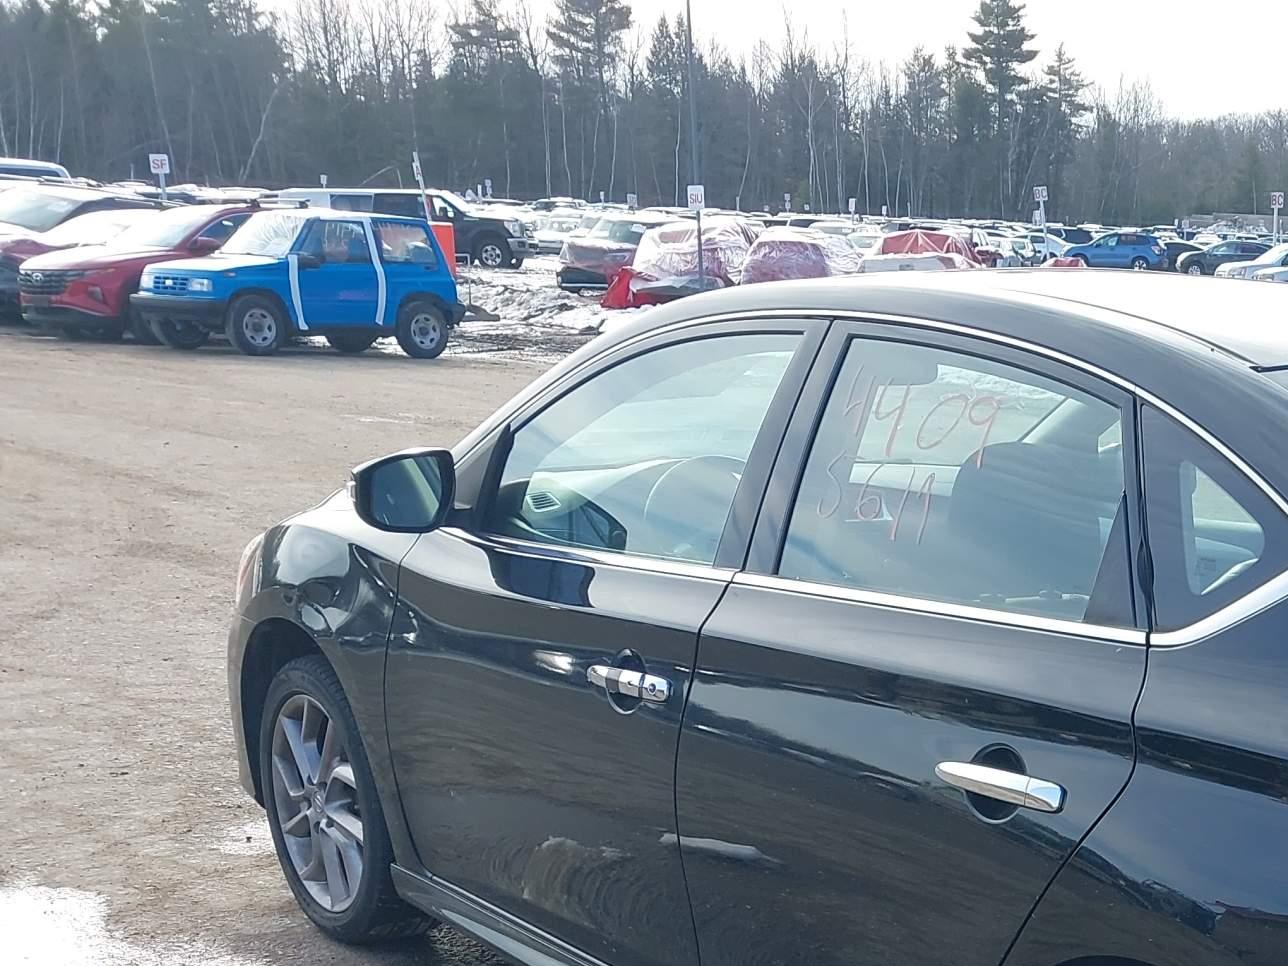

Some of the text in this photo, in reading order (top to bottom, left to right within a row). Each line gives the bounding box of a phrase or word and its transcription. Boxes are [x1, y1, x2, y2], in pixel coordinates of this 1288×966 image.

[151, 158, 167, 170] SF
[689, 193, 703, 205] SIU
[1034, 188, 1047, 200] BC
[1271, 194, 1284, 206] BC
[842, 361, 1003, 471] 4409
